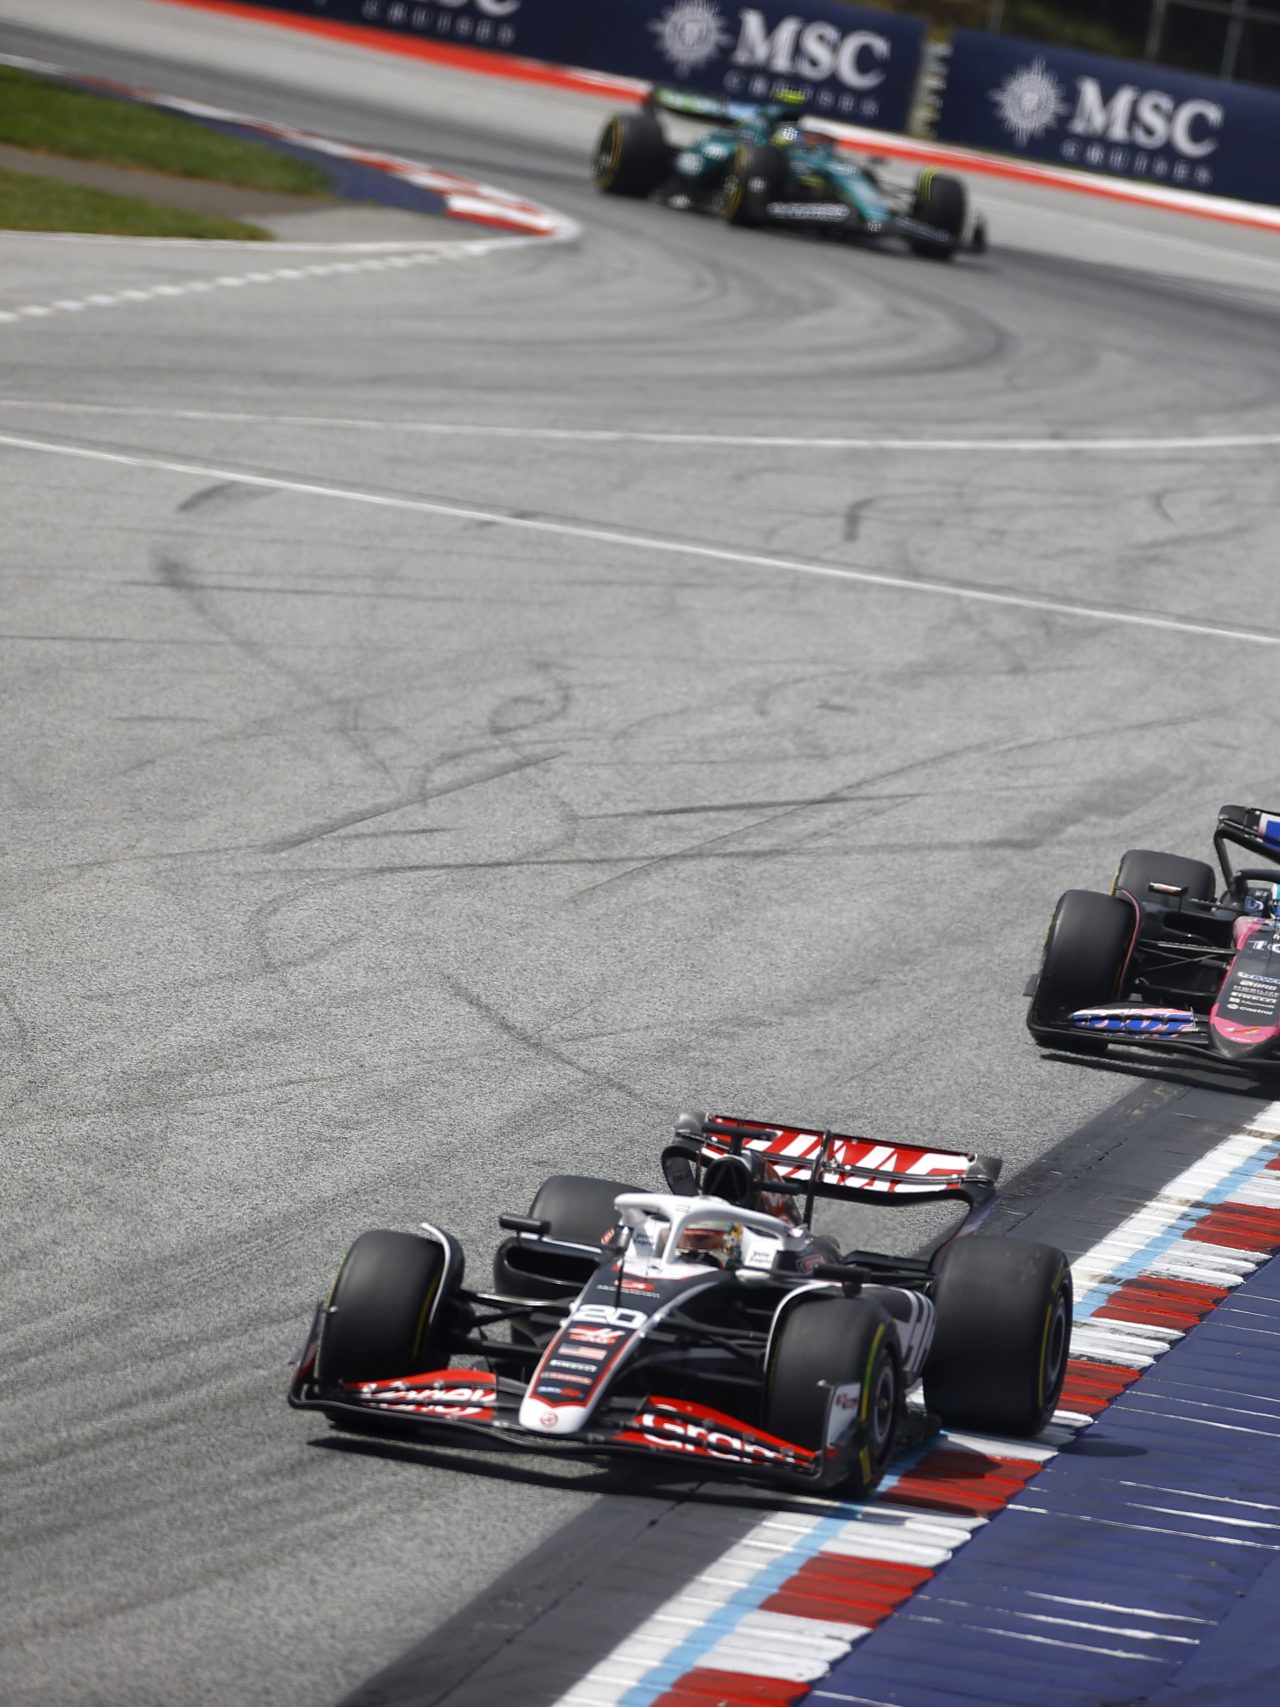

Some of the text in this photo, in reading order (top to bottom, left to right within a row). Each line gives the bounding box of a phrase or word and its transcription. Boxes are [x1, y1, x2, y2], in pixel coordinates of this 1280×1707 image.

[731, 9, 890, 90] MSC
[1068, 75, 1224, 158] MSC
[571, 1303, 648, 1329] 20
